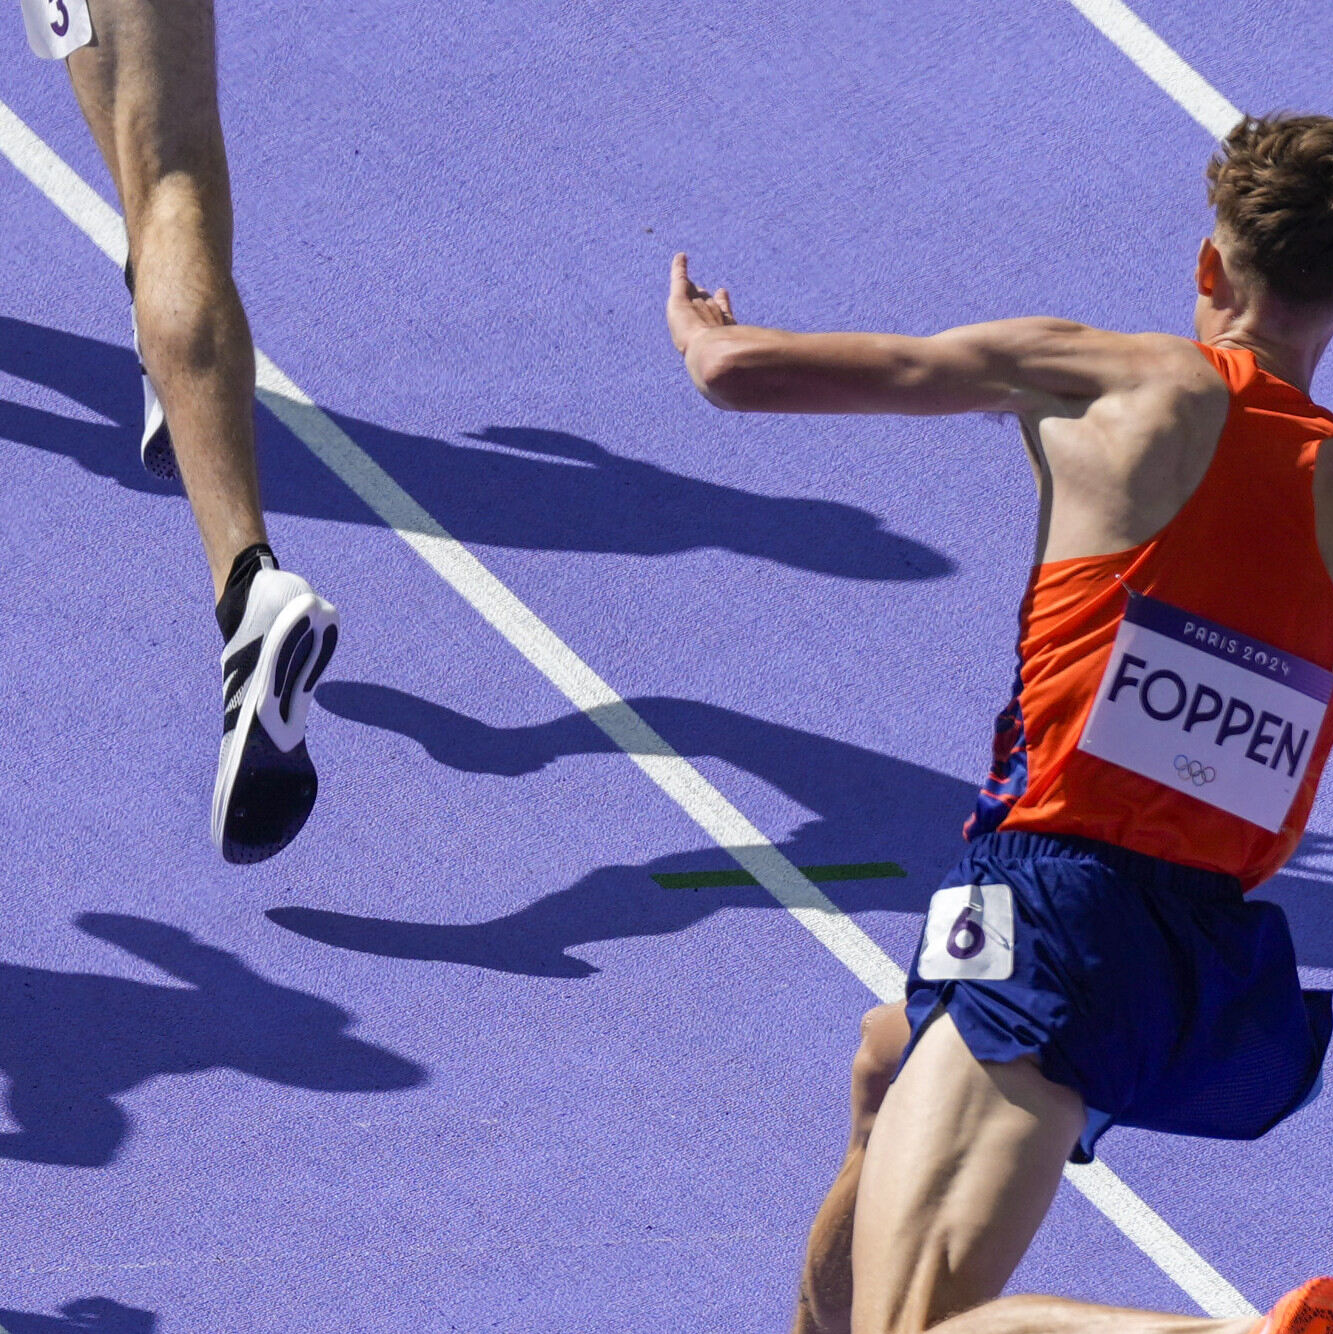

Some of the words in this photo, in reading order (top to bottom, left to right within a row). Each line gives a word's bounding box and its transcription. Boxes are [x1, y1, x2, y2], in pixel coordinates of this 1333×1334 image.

[1183, 621, 1238, 654] PARIS
[1243, 645, 1291, 677] 2024
[1107, 653, 1310, 778] FOPPEN
[946, 906, 986, 960] 6
